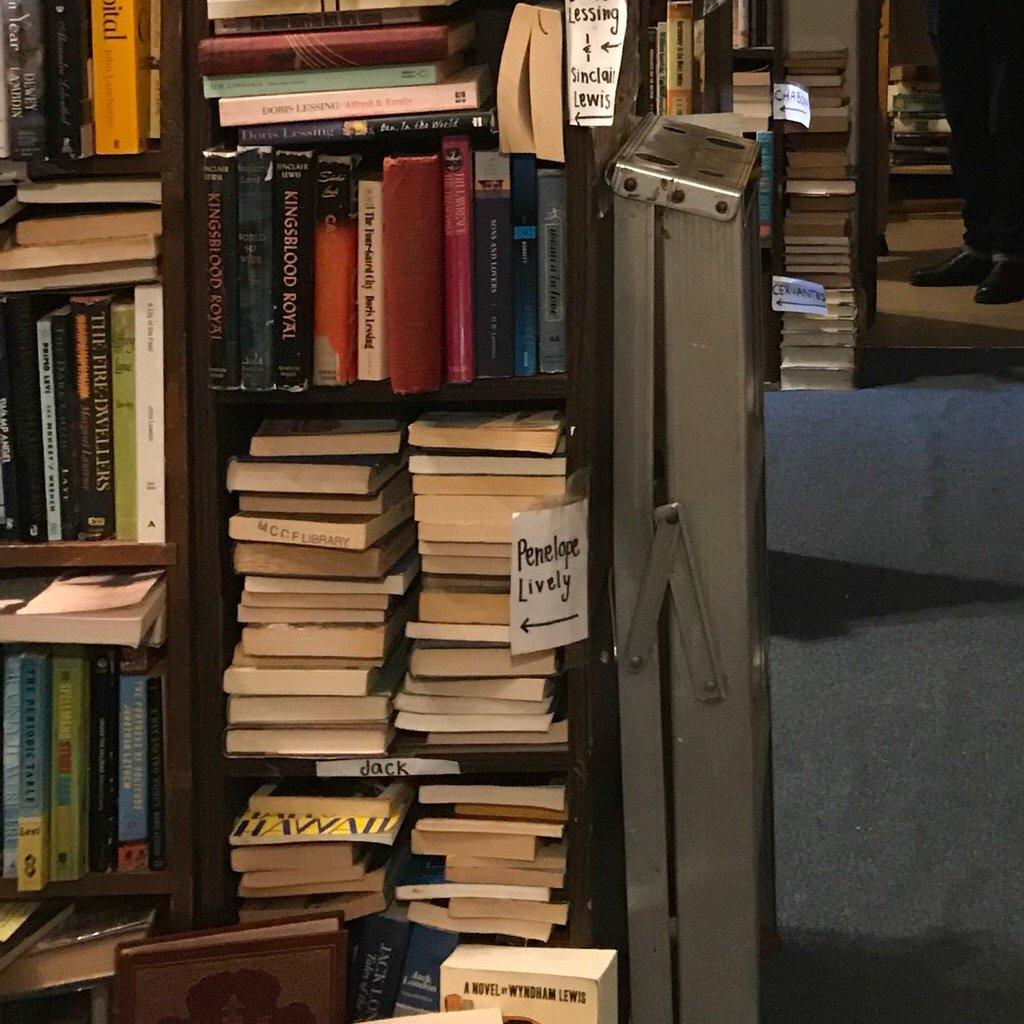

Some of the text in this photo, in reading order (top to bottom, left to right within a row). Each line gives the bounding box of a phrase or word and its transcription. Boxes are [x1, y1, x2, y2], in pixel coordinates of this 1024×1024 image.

[7, 12, 30, 52] Year
[567, 6, 620, 36] Lessing
[101, 48, 115, 73] John
[571, 66, 617, 85] Sinclair
[9, 65, 23, 118] LAMBDIN
[22, 72, 38, 111] DEWEY
[262, 104, 295, 116] DORIS
[295, 100, 342, 113] LESSING
[343, 98, 373, 109] Alfred
[384, 96, 413, 108] Emily
[573, 90, 612, 111] Lewis
[241, 117, 460, 142] Doris Lessing the World
[207, 192, 223, 340] KINGSBLOOD ROYAL
[281, 190, 298, 340] KINGSBLOOD ROYAL
[489, 218, 498, 294] SONS AND LOVERS
[362, 210, 377, 350] The Four-Gated City Doris Lessing
[42, 342, 51, 395] PRIMO LEVI
[90, 310, 111, 493] THE FIRE-DWELLERS
[301, 533, 351, 548] LIBRARY
[516, 534, 582, 572] Penelope
[517, 570, 573, 603] Lively
[25, 668, 36, 804] THE PERIODIC TABLE
[359, 759, 410, 777] Jack
[463, 981, 587, 1005] A NOVEL WYNDHAM LEWIS
